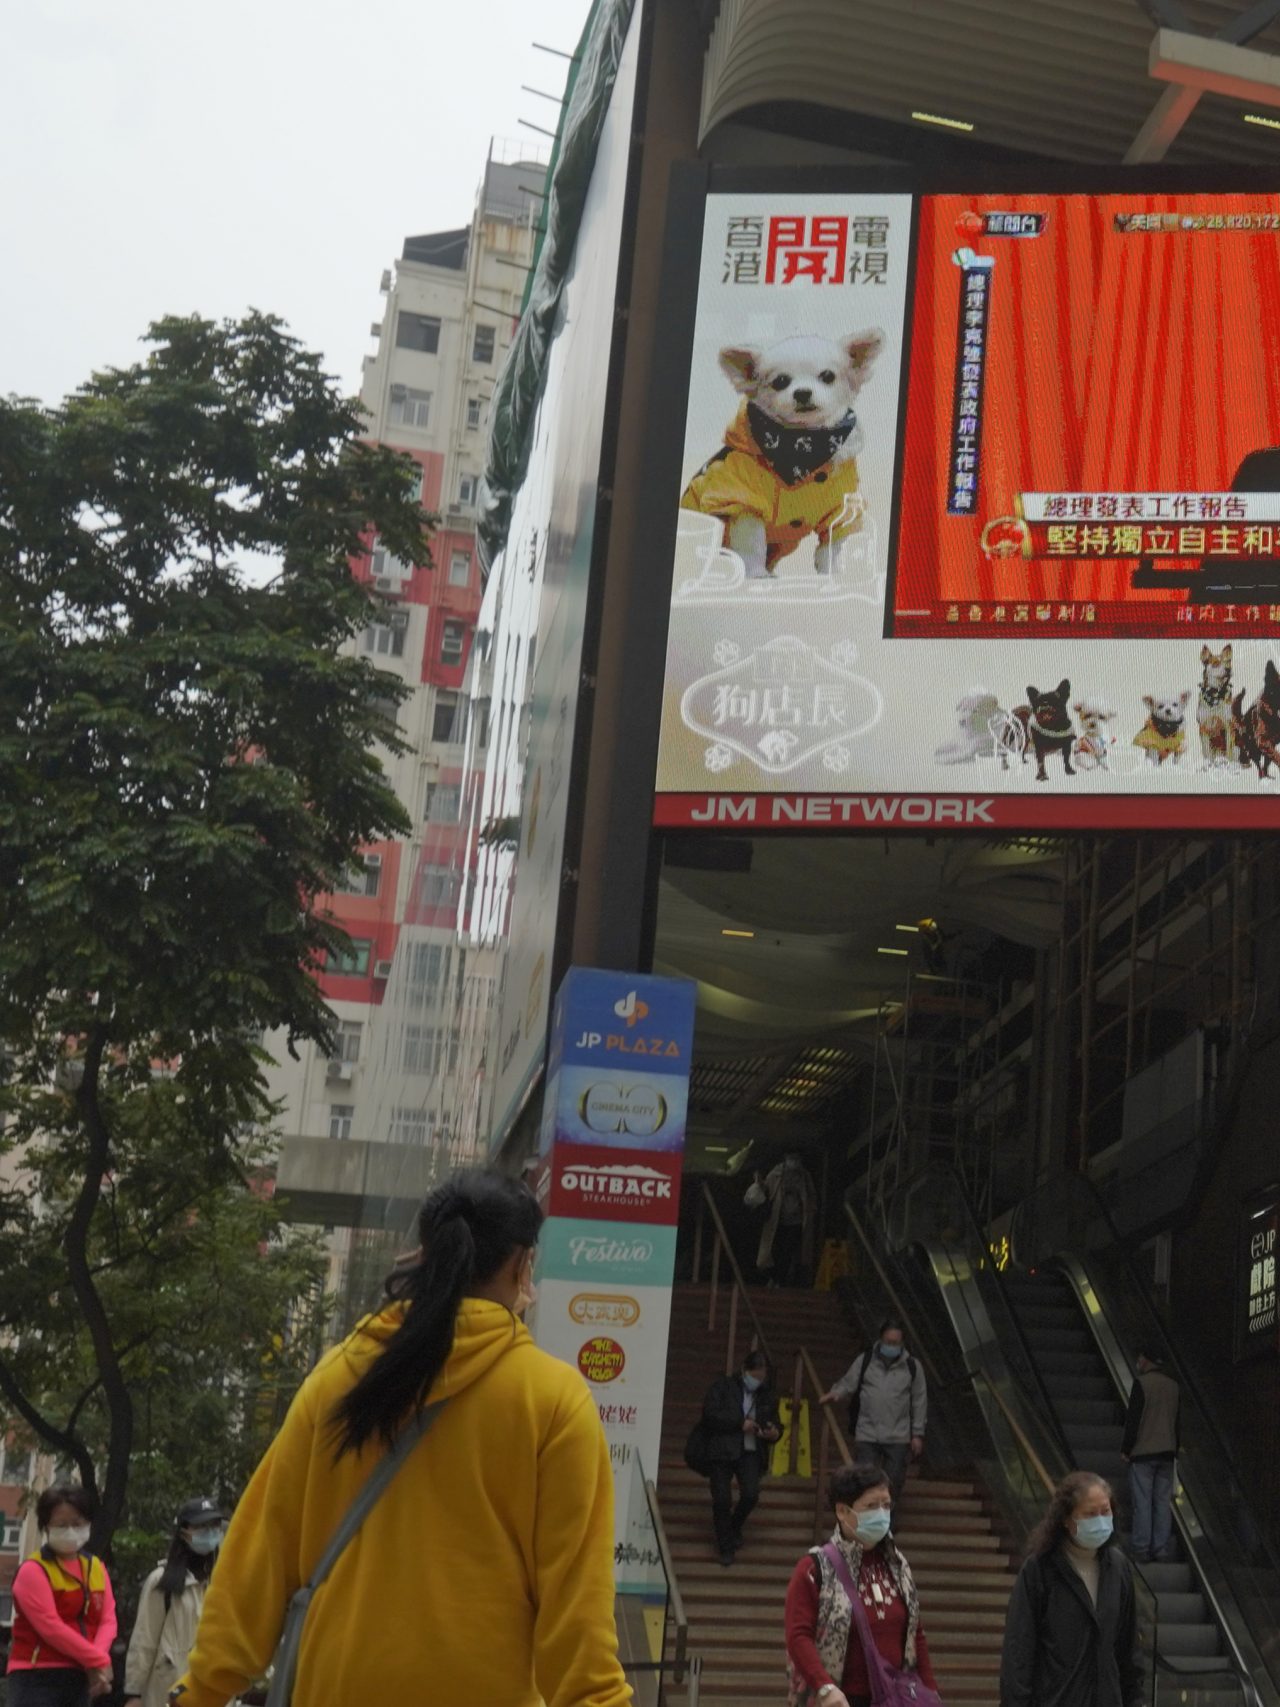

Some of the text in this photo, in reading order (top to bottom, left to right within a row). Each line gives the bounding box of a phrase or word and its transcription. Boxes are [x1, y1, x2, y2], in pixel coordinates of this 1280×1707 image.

[722, 215, 890, 285] 香港 開 電視
[1043, 496, 1248, 519] 總理發表工作報告
[691, 797, 996, 823] JM NETWORK
[576, 1031, 681, 1057] JP PLAZA
[560, 1172, 672, 1199] OUTBACK
